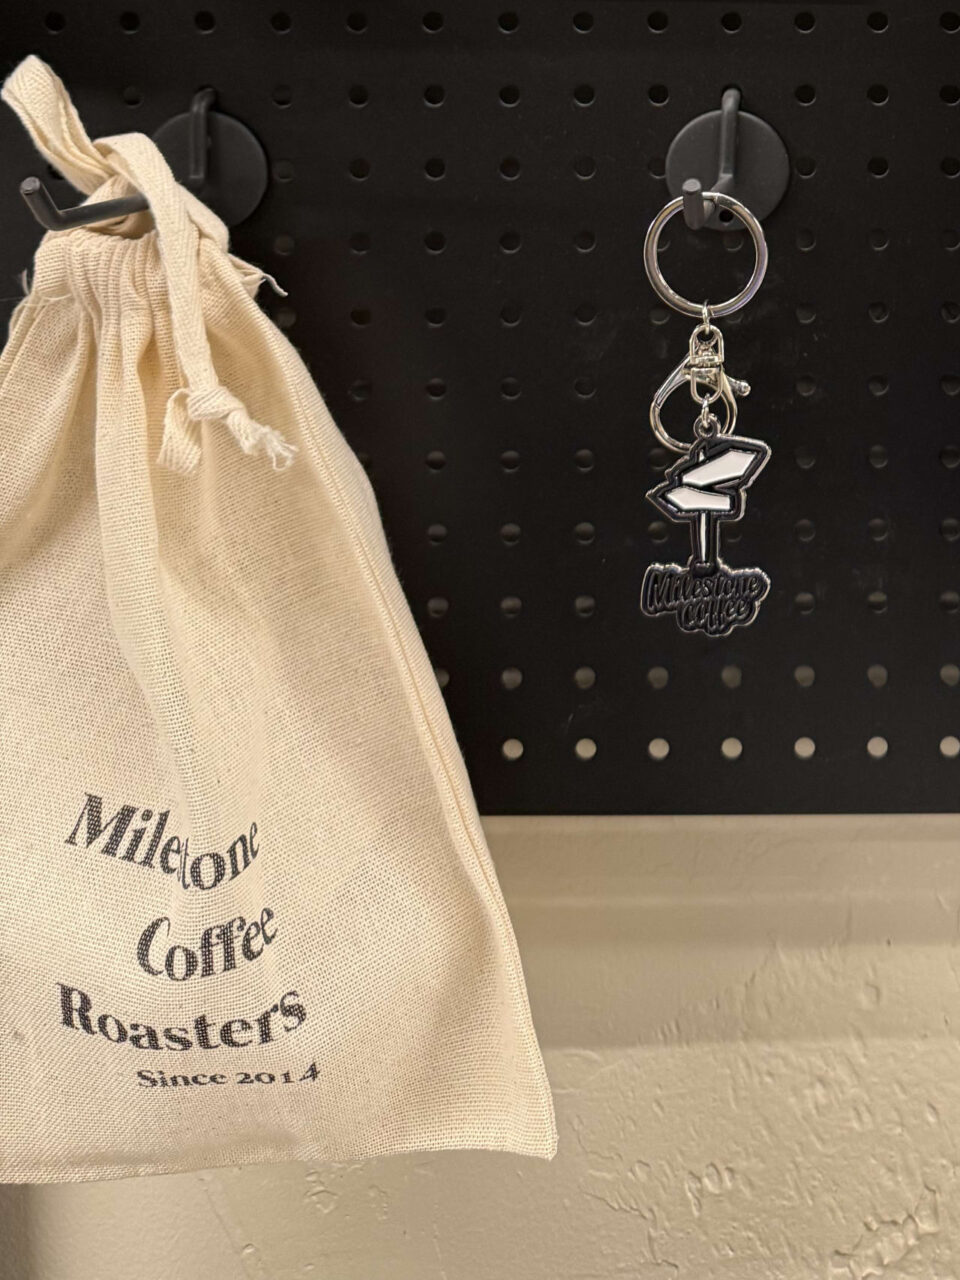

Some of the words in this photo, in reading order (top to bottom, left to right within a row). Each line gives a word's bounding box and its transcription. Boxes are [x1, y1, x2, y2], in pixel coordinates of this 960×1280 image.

[64, 792, 260, 890] Miletone
[136, 907, 278, 981] Coffee
[56, 982, 307, 1051] Roasters
[136, 1069, 227, 1088] Since
[235, 1061, 321, 1085] 2014
